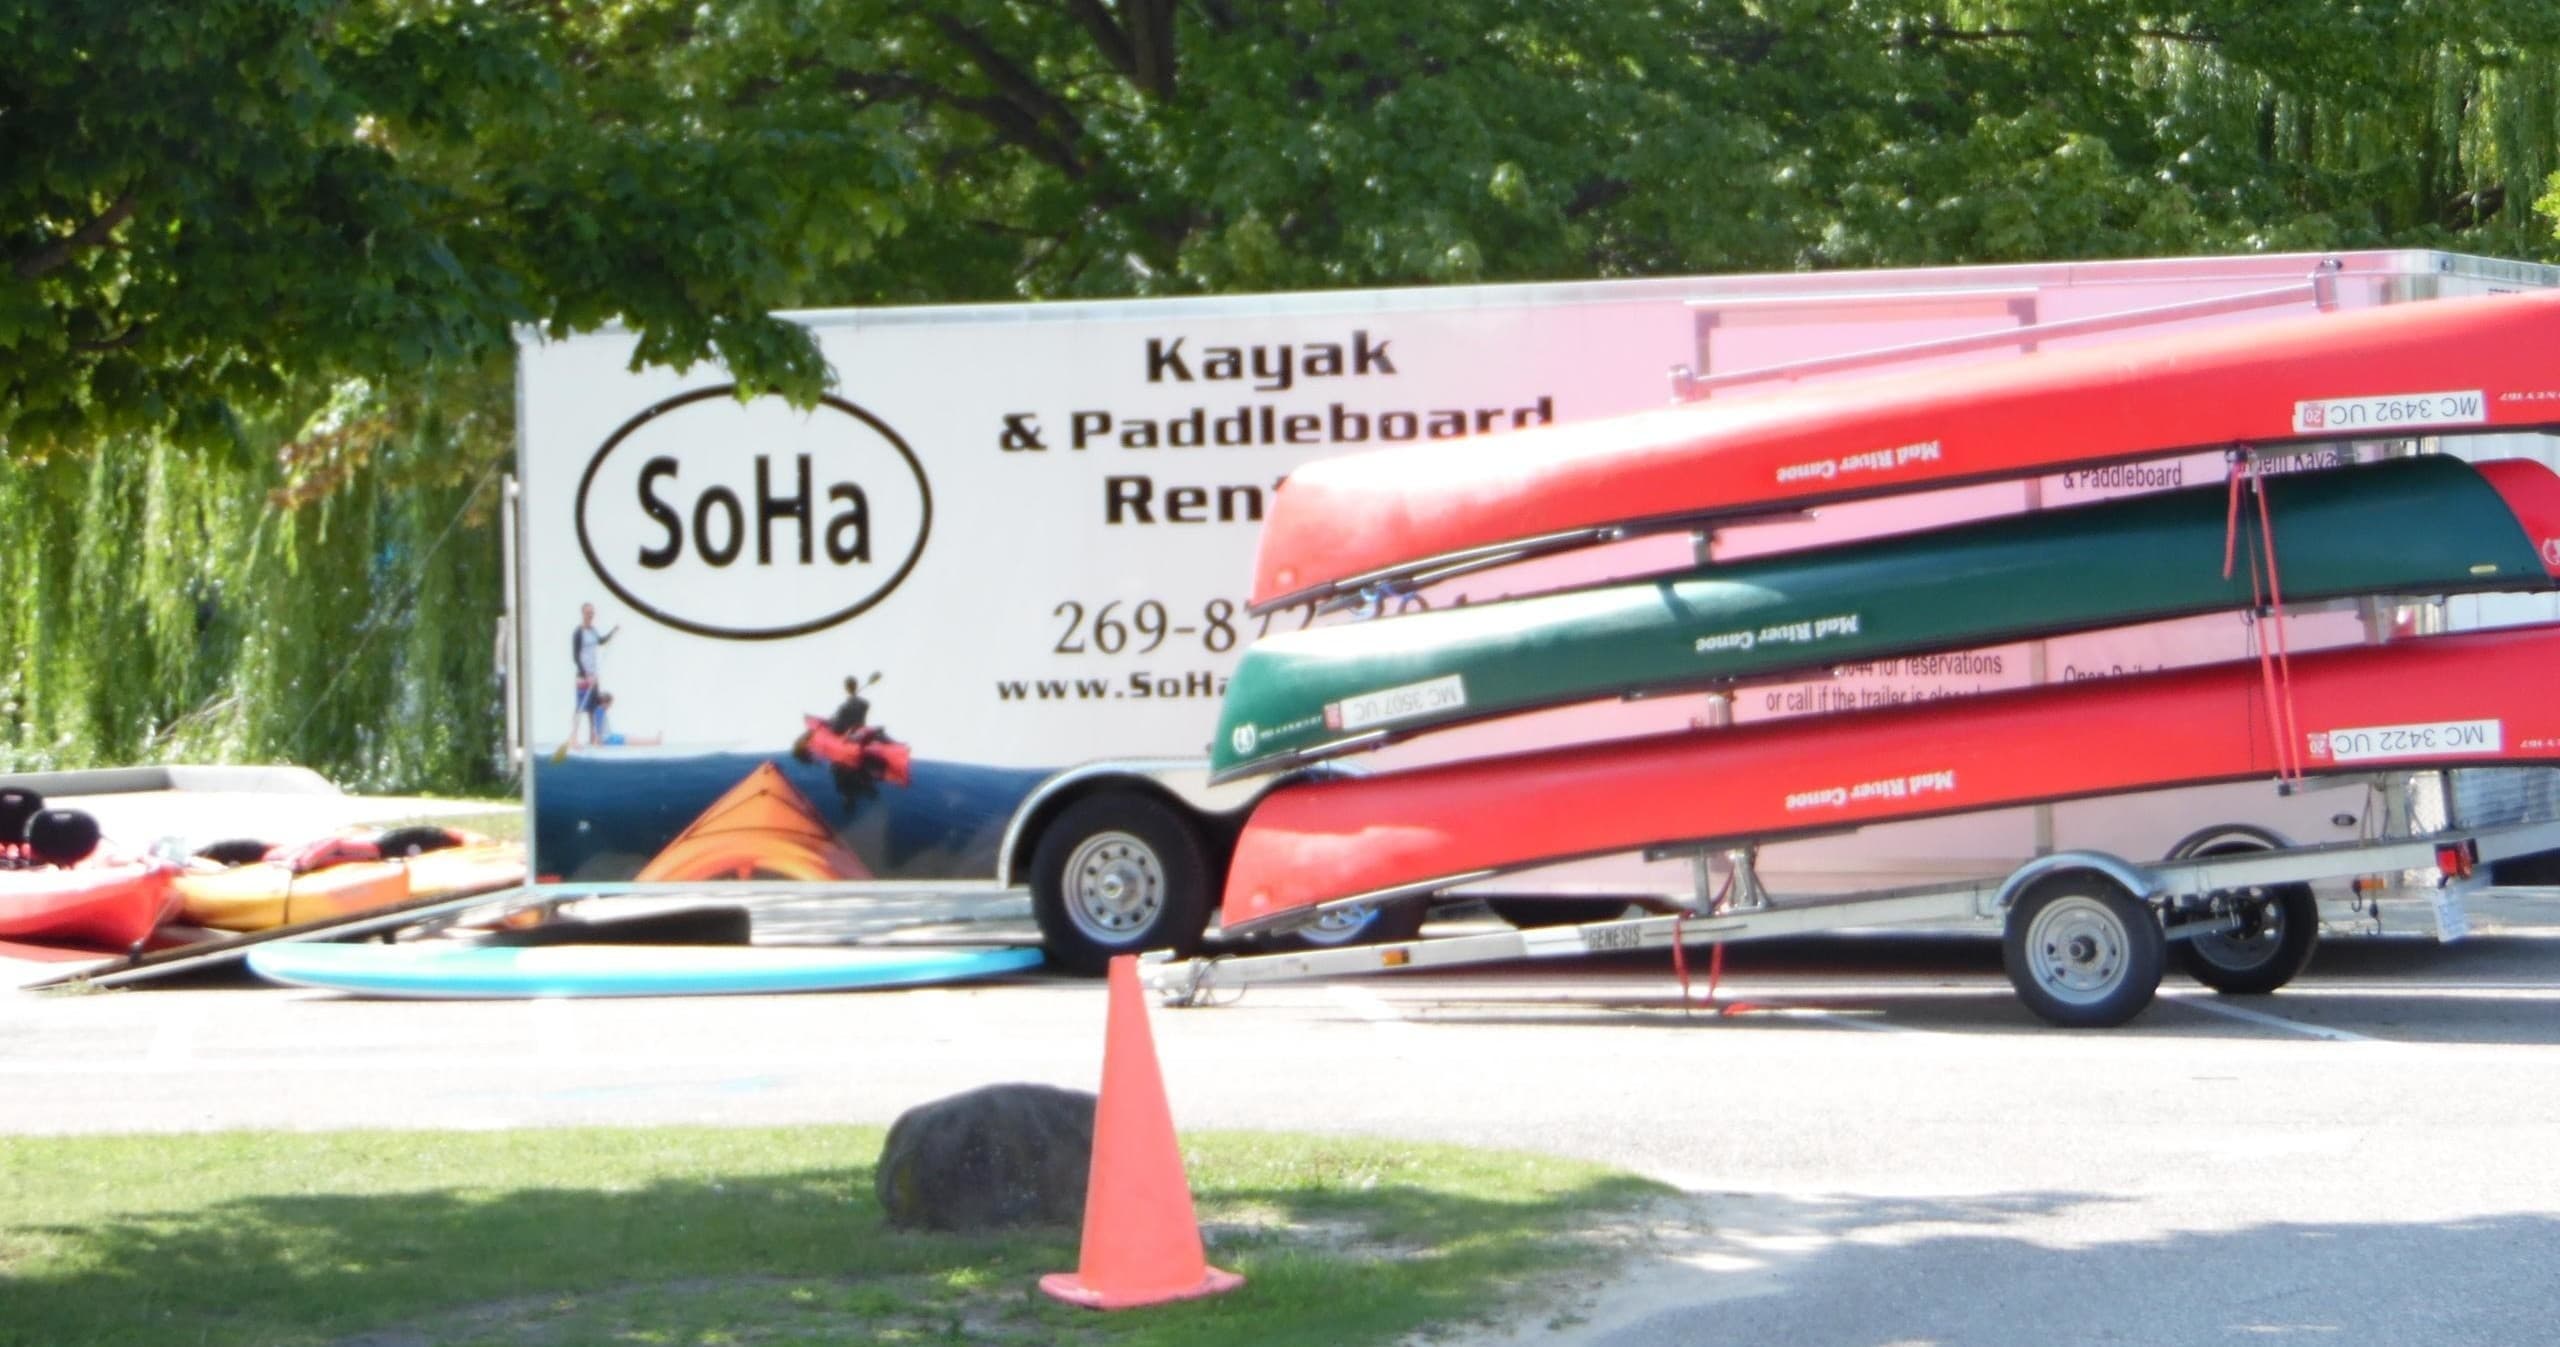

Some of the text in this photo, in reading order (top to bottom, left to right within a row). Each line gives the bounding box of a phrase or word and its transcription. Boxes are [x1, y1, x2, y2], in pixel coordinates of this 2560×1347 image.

[1146, 330, 1397, 391] Kayak
[999, 396, 1553, 452] & Paddleboard
[2331, 397, 2479, 425] MC 3492 UC
[1776, 440, 1940, 482] Mad River Canoe
[2080, 460, 2182, 488] Paddleboard
[637, 453, 871, 569] SoHa
[1105, 475, 1286, 524] Ren
[1695, 614, 1858, 651] Mad River Canoe
[1905, 652, 2002, 676] reservations
[1766, 692, 1782, 711] or
[1787, 686, 1812, 711] call
[1818, 686, 1828, 711] if
[1833, 686, 1856, 710] the
[1861, 685, 1905, 707] trailer
[2335, 725, 2484, 755] MC 3422 UC
[1785, 770, 1955, 810] Mad River Canoe
